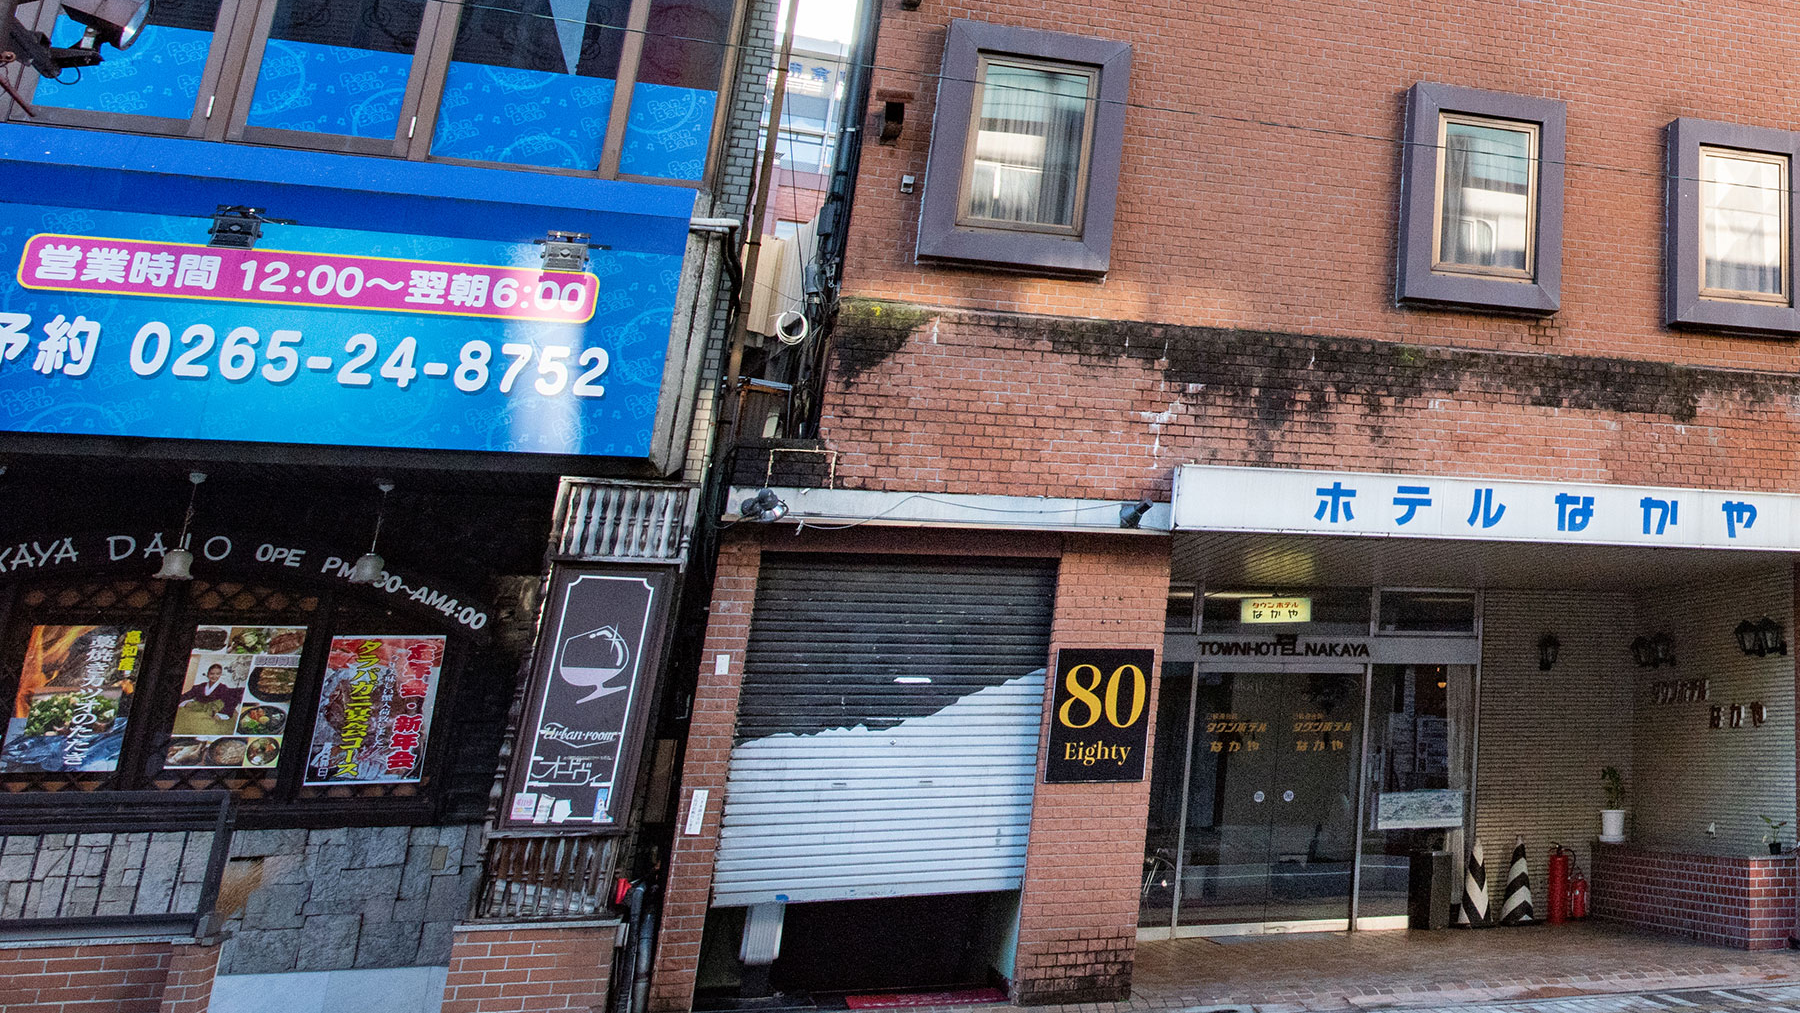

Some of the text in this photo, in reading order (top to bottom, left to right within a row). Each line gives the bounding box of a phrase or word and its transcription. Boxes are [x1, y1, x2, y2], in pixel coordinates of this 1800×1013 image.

[35, 244, 222, 291] 営業時間
[130, 321, 609, 398] 0265-24-8752
[255, 543, 306, 568] OPE
[1251, 601, 1299, 609] タウンホテル
[1252, 609, 1299, 619] なかや
[1304, 642, 1370, 658] NAKAYA
[333, 639, 383, 777] タラバガニ宴会コース
[1058, 663, 1147, 729] 80
[1063, 740, 1132, 767] Eighty
